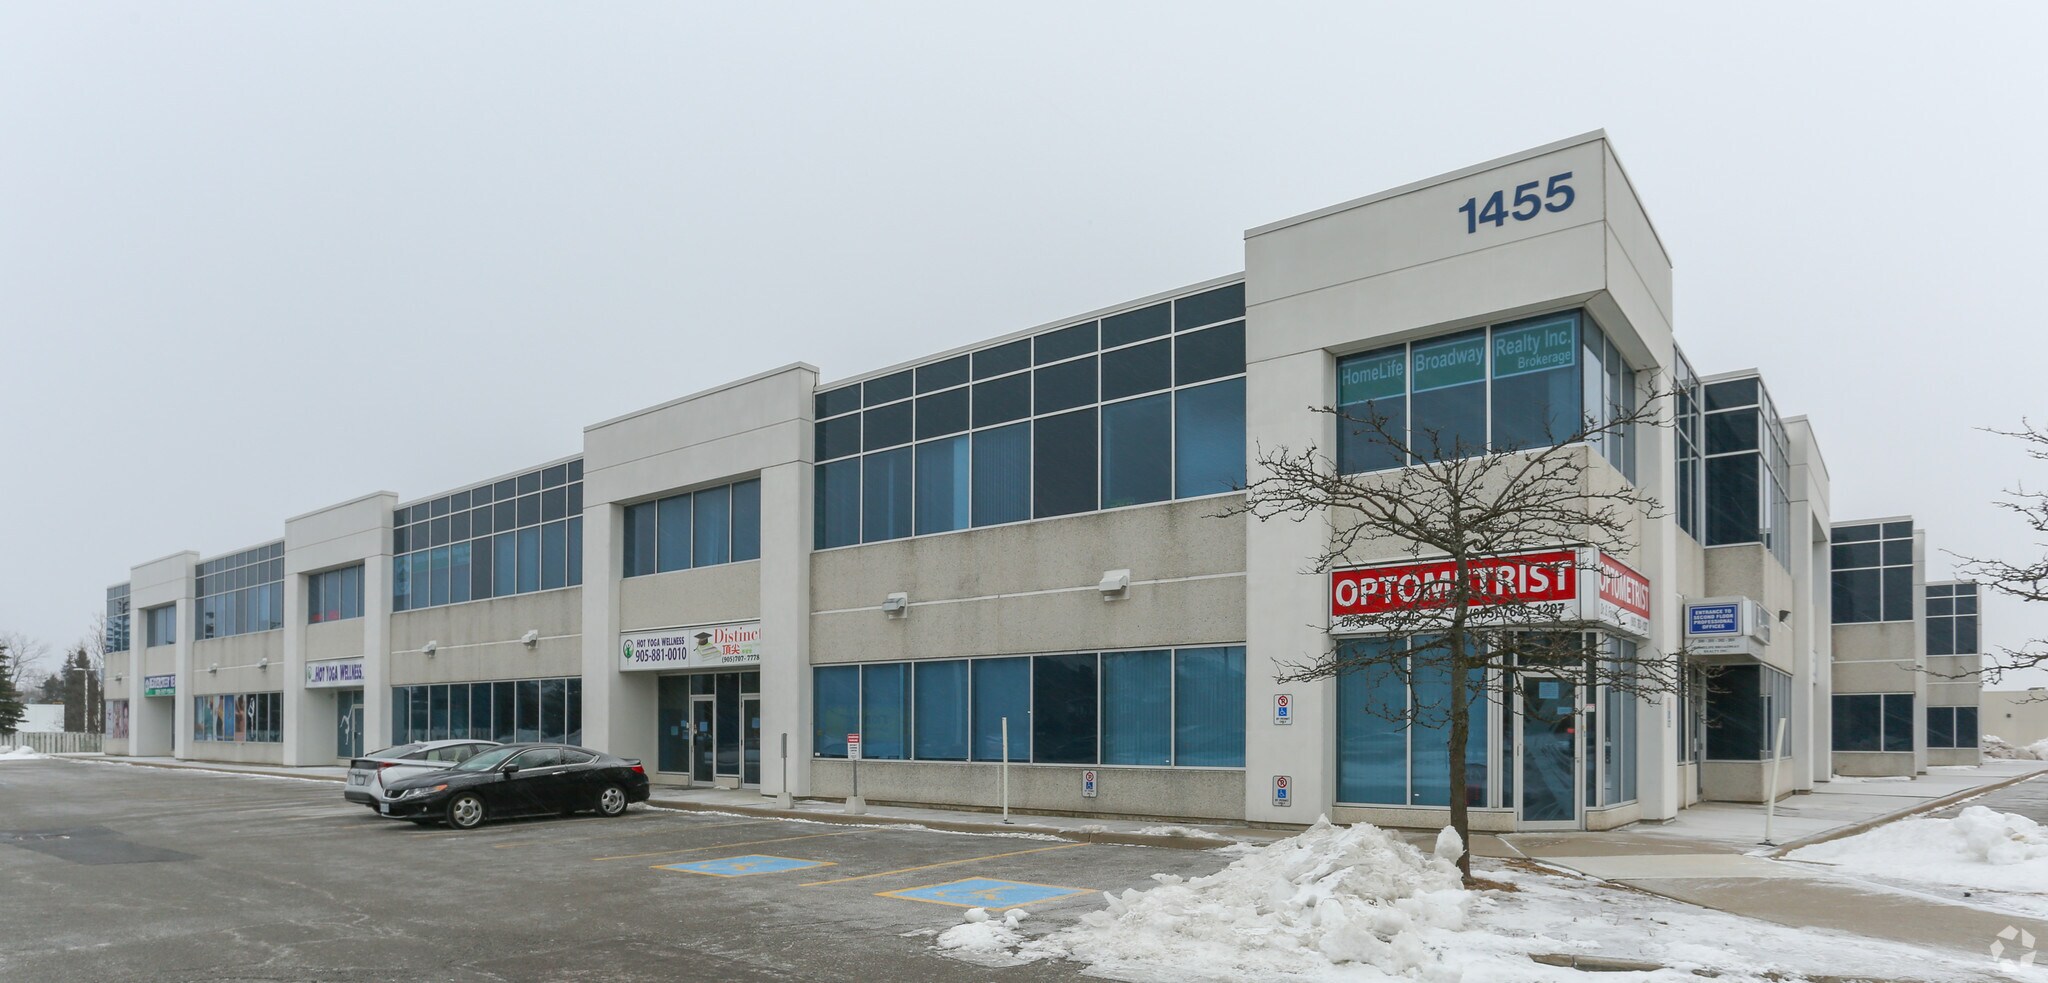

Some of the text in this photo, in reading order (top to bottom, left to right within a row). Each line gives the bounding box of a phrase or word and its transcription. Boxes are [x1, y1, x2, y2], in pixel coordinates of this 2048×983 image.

[1459, 171, 1576, 234] 1455
[1342, 329, 1571, 386] HomeLife Broadway Realty Inc.
[1518, 351, 1571, 369] Brokerage
[1335, 560, 1572, 607] OPTOMTRIST
[1599, 561, 1649, 612] OPTOMETRIST
[635, 647, 687, 662] 905-881-0010
[636, 636, 684, 648] HOT YOGA WELLNESS
[315, 664, 362, 682] HOT YOGA WELLNESS
